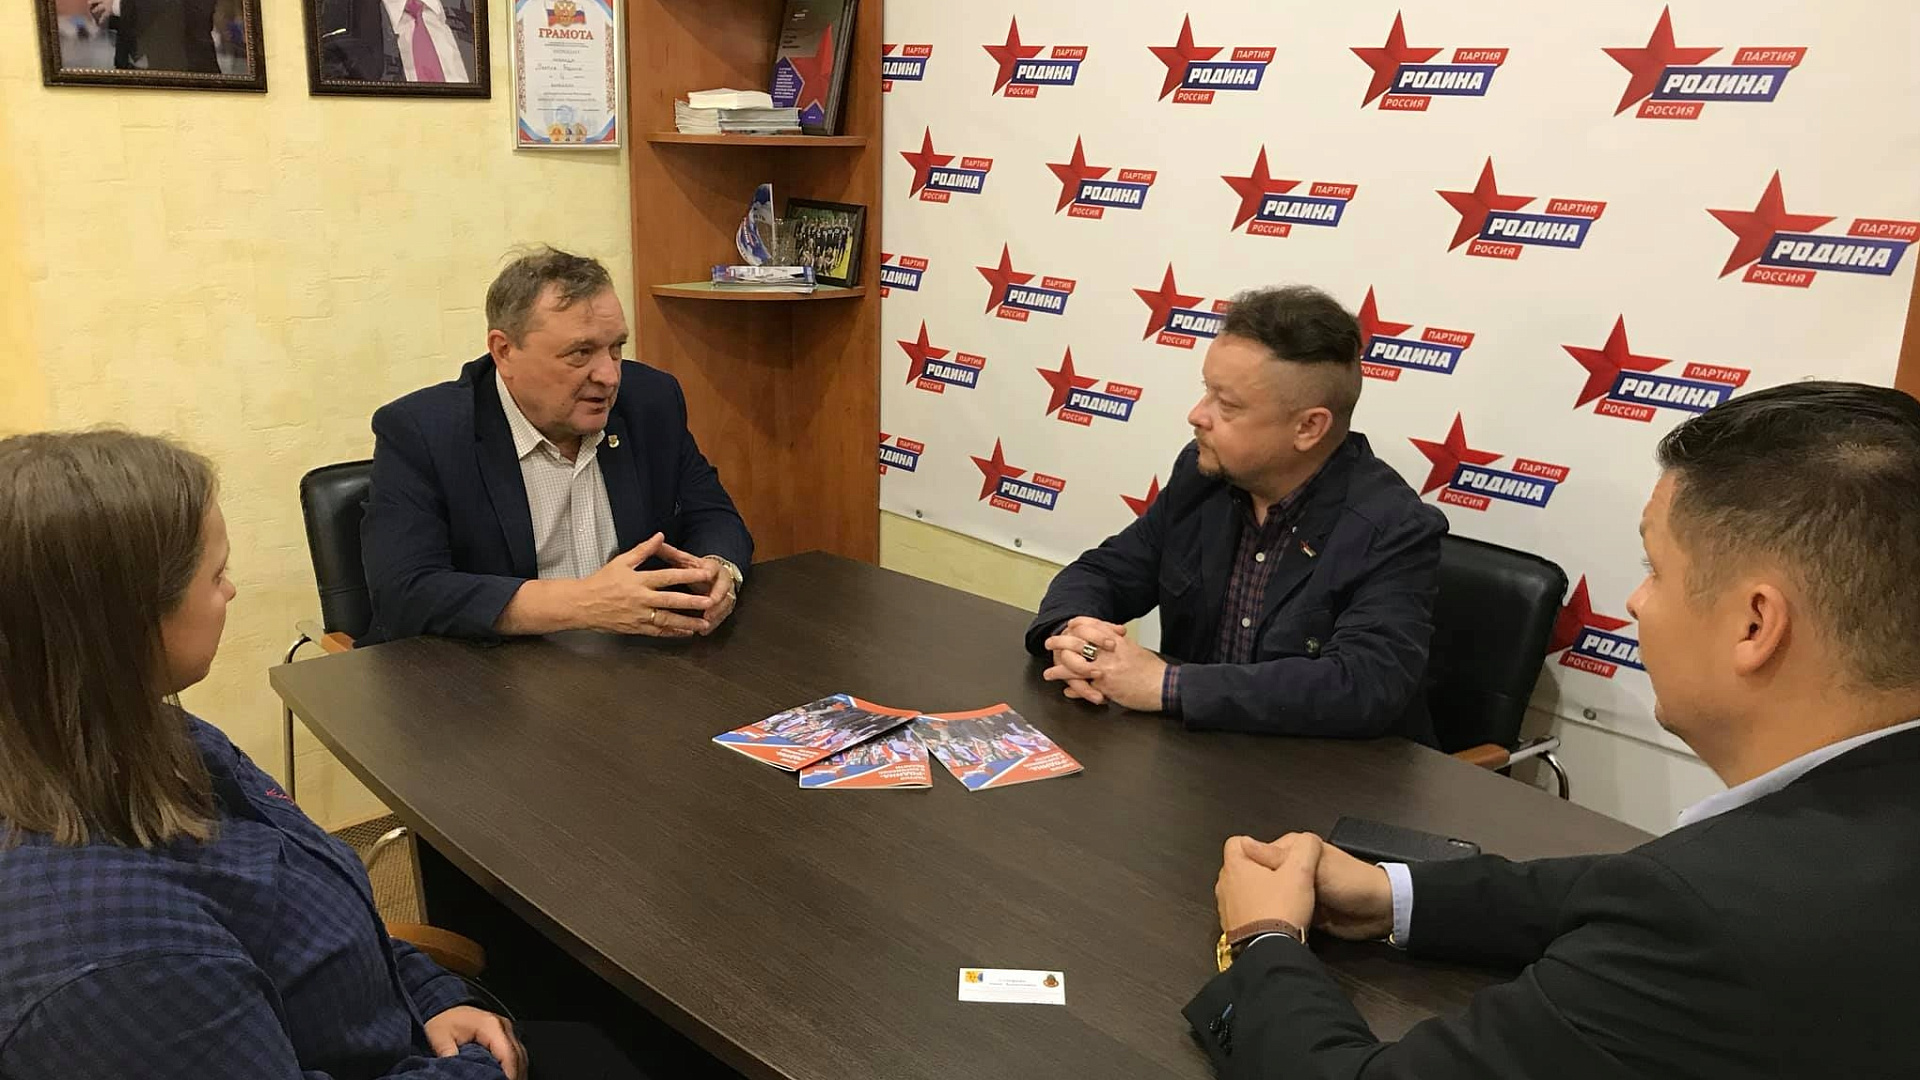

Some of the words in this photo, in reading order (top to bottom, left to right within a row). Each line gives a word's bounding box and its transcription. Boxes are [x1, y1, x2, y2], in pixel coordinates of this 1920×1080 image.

[539, 28, 594, 40] ГРАМОТА
[1055, 48, 1083, 57] ПАРТИЯ
[1236, 50, 1271, 59] ПАРТИЯ
[1458, 52, 1501, 61] ПАРТИЯ
[1741, 51, 1798, 62] ПАРТИЯ
[883, 62, 921, 76] ОДИНА
[1016, 65, 1074, 80] РОДИНА
[1188, 68, 1258, 85] РОДИНА
[1398, 71, 1485, 89] РОДИНА
[1662, 74, 1774, 95] РОДИНА
[1008, 87, 1035, 96] РОССИЯ
[1177, 92, 1210, 101] РОССИЯ
[1385, 98, 1425, 108] РОССИЯ
[1644, 105, 1695, 116] РОССИЯ
[964, 160, 990, 168] ПАРТИЯ
[930, 171, 980, 189] РОДИНА
[1122, 172, 1152, 181] ПАРТИЯ
[923, 191, 947, 201] РОССИЯ
[1081, 185, 1141, 204] РОДИНА
[1314, 185, 1351, 195] ПАРТИЯ
[1072, 206, 1100, 217] РОССИЯ
[1263, 200, 1337, 221] РОДИНА
[1552, 202, 1598, 213] ПАРТИЯ
[1252, 224, 1287, 234] РОССИЯ
[1488, 218, 1581, 242] РОДИНА
[1857, 223, 1917, 236] ПАРТИЯ
[1473, 244, 1516, 256] РОССИЯ
[1771, 240, 1892, 268] РОДИНА
[881, 268, 917, 287] ОДИНА
[1752, 270, 1806, 283] РОССИЯ
[1008, 289, 1062, 310] РОДИНА
[1161, 335, 1192, 346] РОССИЯ
[1427, 330, 1468, 343] ПАРТИЯ
[1370, 342, 1452, 368] РОДИНА
[926, 362, 974, 385] РОДИНА
[1691, 367, 1741, 382] ПАРТИЯ
[919, 380, 942, 392] РОССИЯ
[1110, 385, 1139, 397] ПАРТИЯ
[1618, 377, 1720, 408] РОДИНА
[1070, 393, 1128, 417] РОДИНА
[1602, 404, 1649, 418] РОССИЯ
[1061, 412, 1088, 424] РОССИЯ
[1519, 462, 1562, 477] ПАРТИЯ
[1457, 470, 1546, 501] РОДИНА
[1001, 481, 1052, 505] РОДИНА
[1444, 492, 1485, 507] РОССИЯ
[1566, 655, 1611, 676] РОССИЯ
